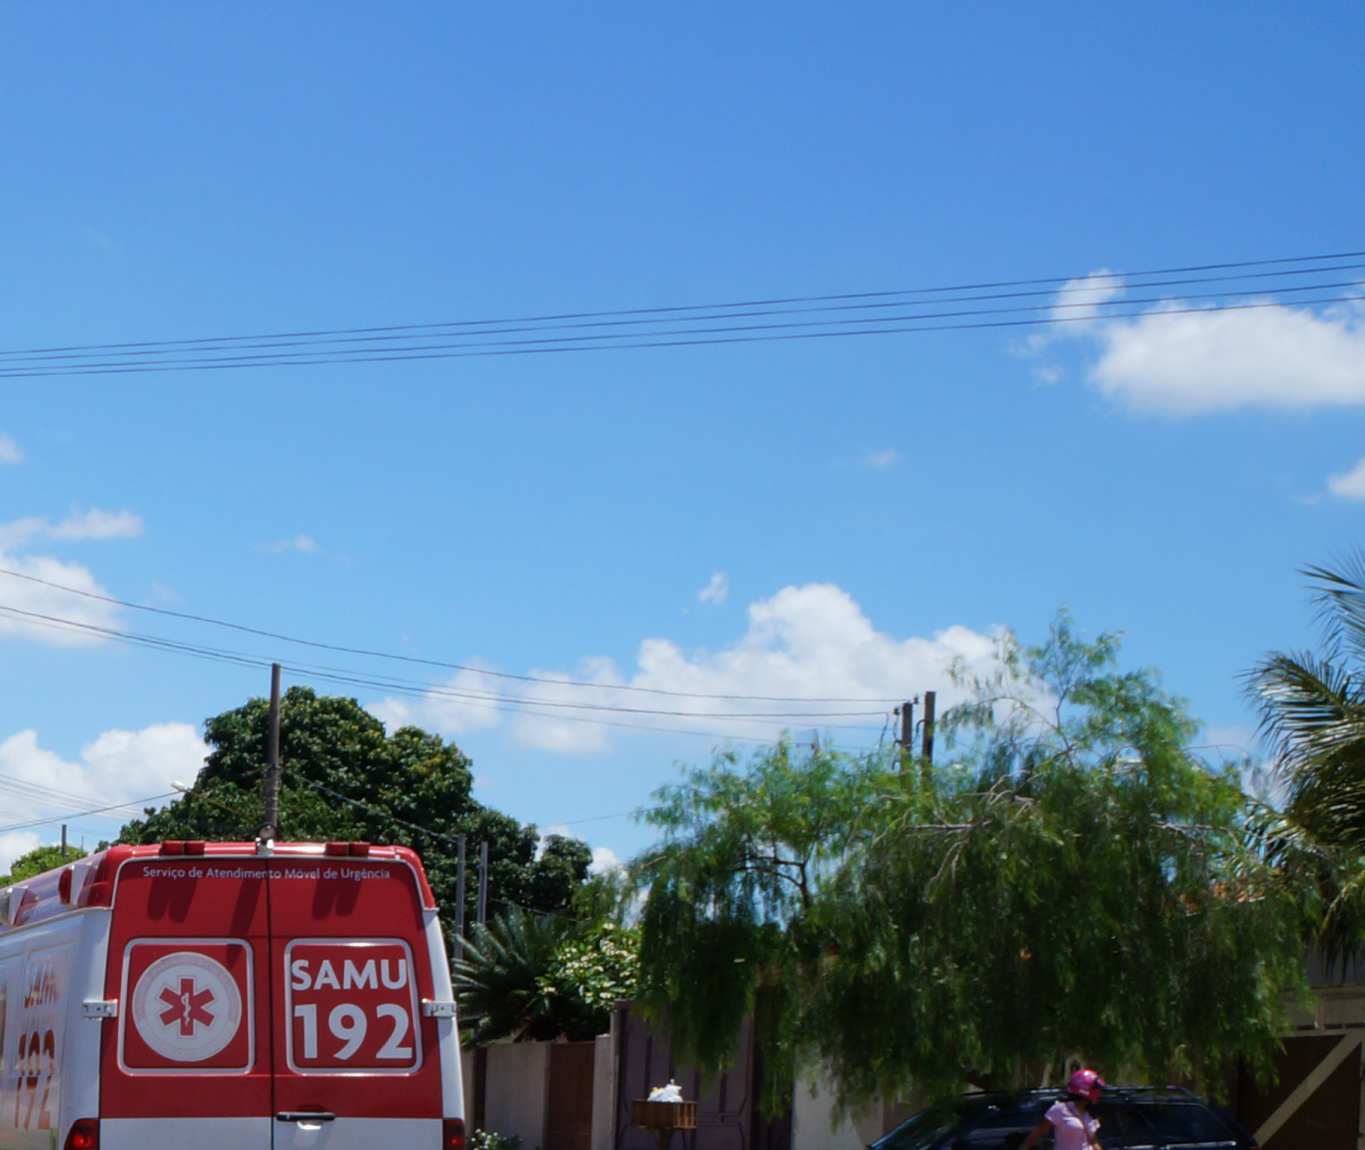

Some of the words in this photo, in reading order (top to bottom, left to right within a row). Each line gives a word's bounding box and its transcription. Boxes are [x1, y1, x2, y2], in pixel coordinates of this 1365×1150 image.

[142, 866, 186, 880] Serviço
[188, 866, 203, 878] de
[206, 867, 281, 879] Atendimento
[284, 867, 320, 879] Móvel
[323, 867, 338, 879] de
[340, 868, 390, 881] Urgência
[291, 958, 407, 991] SAMU
[294, 1002, 412, 1061] 192
